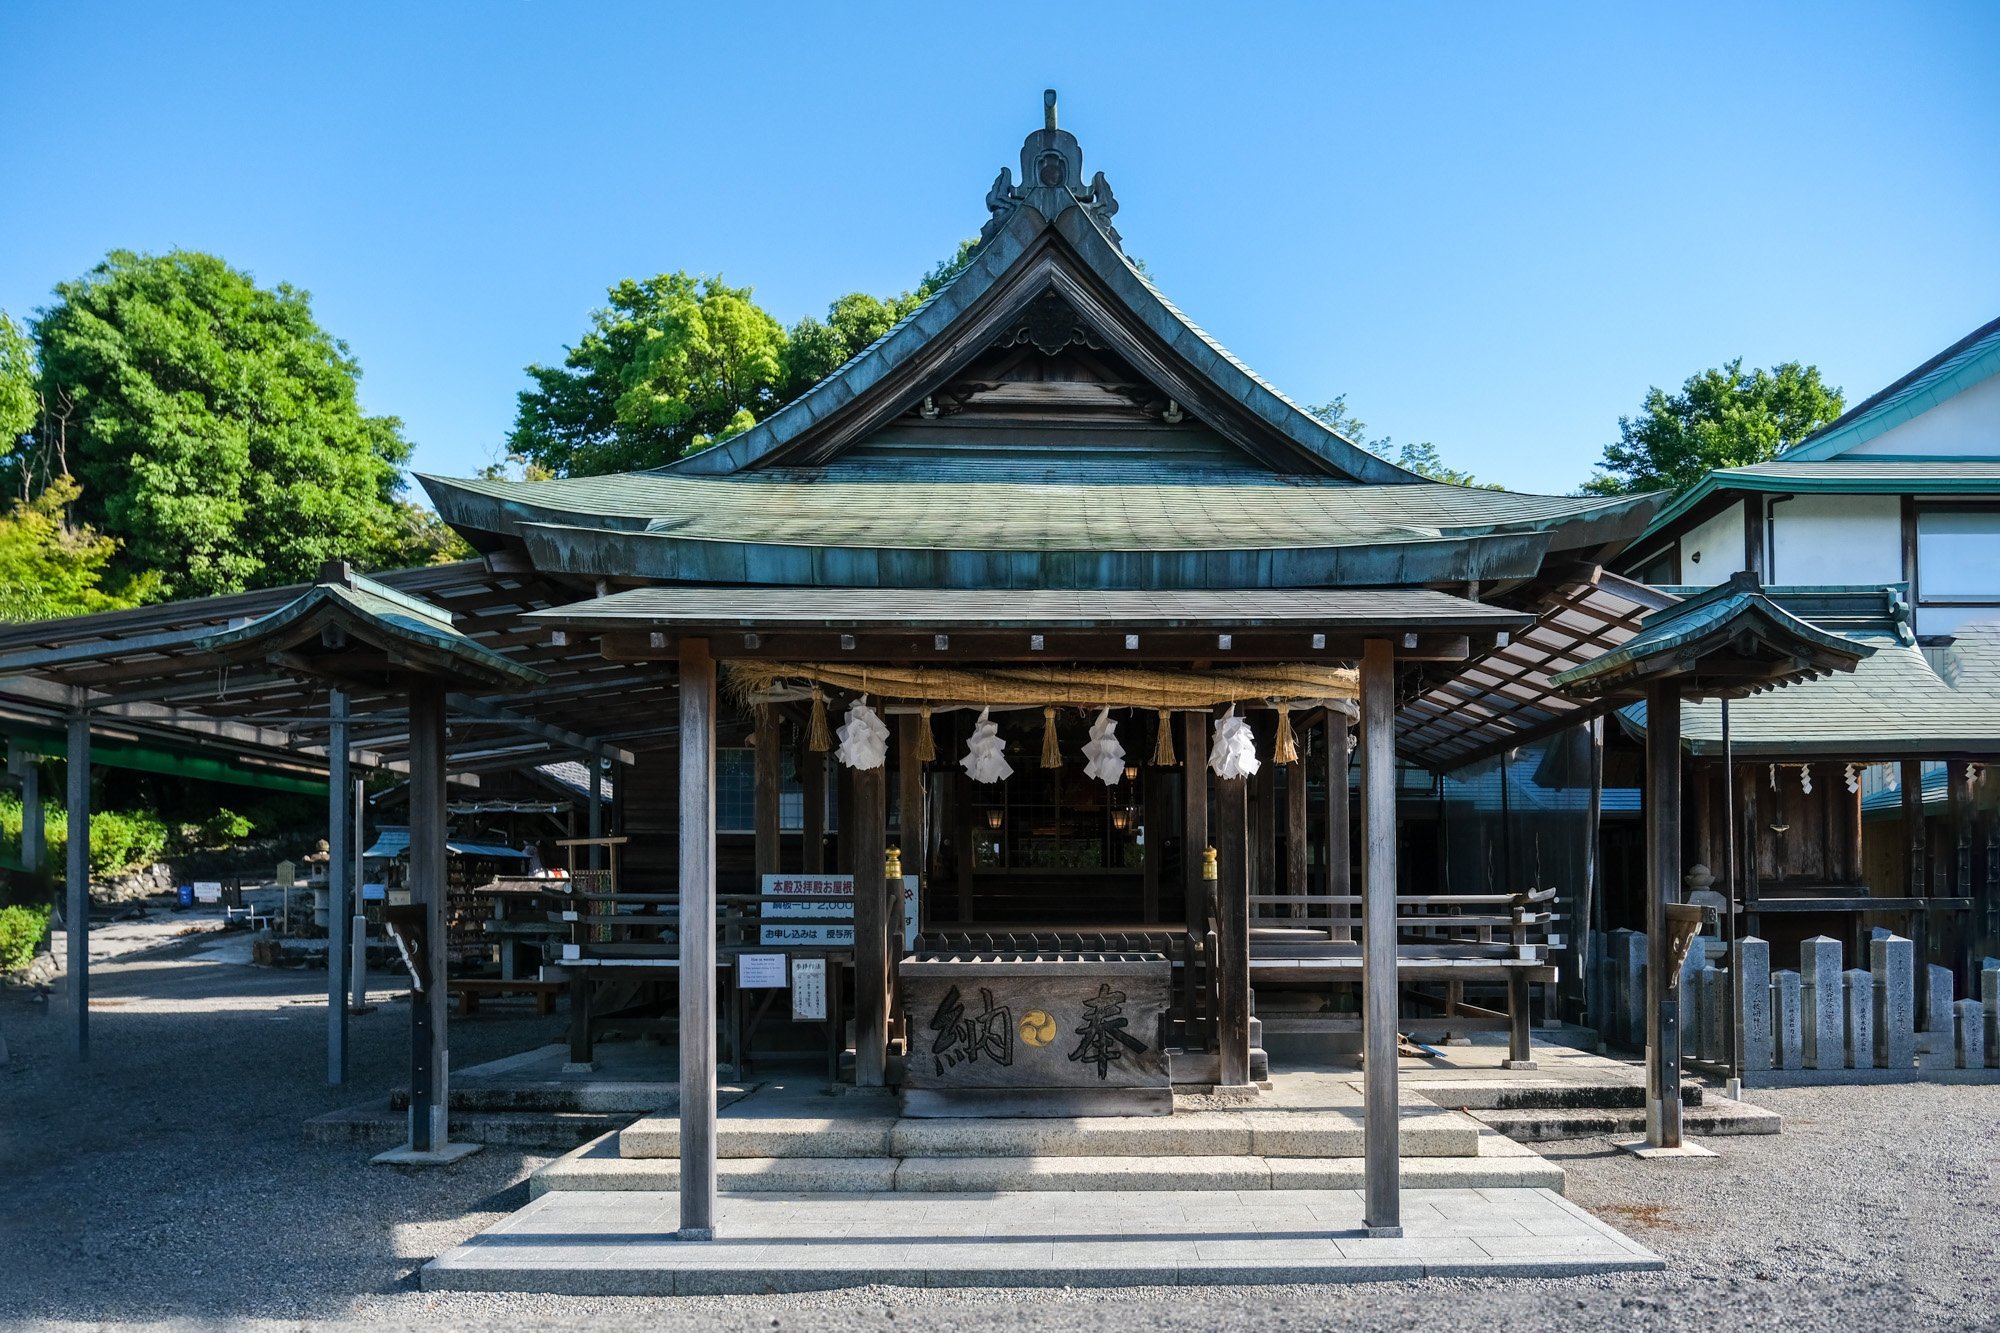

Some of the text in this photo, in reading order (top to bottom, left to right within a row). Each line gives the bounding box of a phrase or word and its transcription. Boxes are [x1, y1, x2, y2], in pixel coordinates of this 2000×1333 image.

[773, 880, 854, 894] 本殿及拝殿お屋根
[765, 929, 854, 939] お申し込みは 授与所
[930, 984, 1015, 1078] 納
[1068, 983, 1149, 1081] 奉
